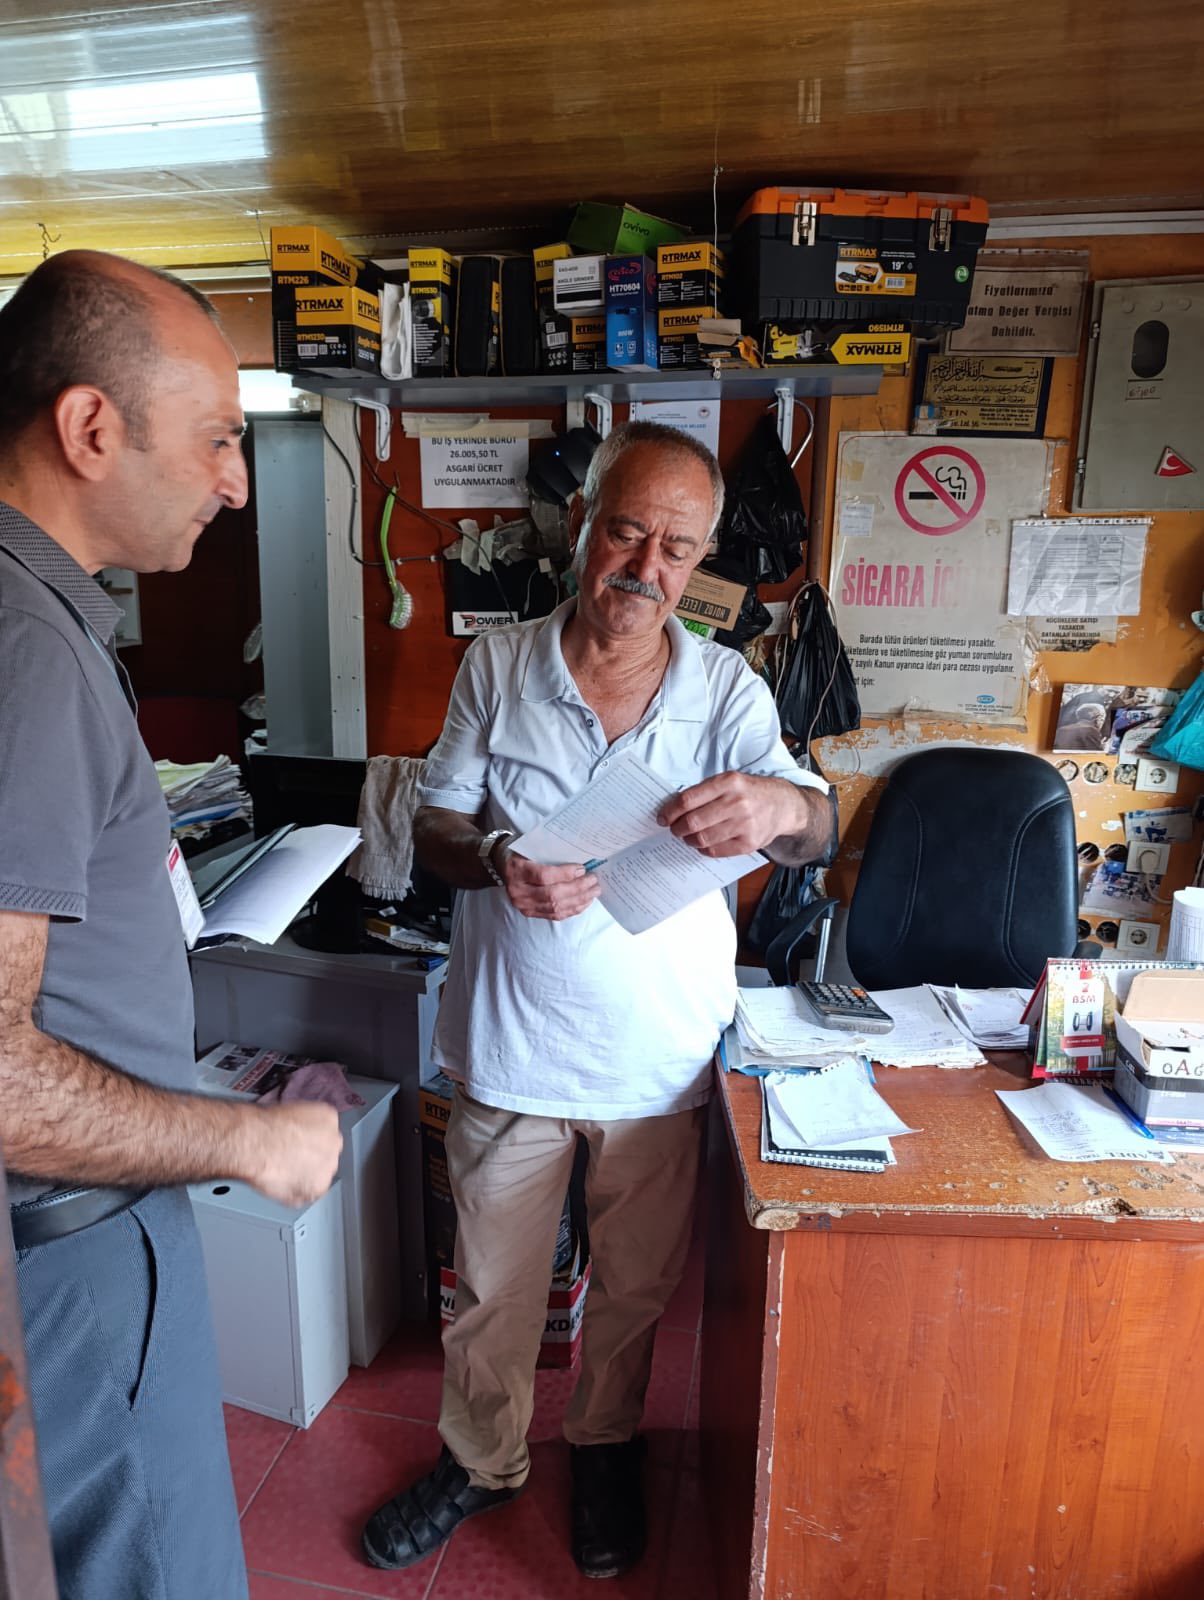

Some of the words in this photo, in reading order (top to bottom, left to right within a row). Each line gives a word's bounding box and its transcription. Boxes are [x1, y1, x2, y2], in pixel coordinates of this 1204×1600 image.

[277, 244, 310, 253] RTRMAX
[840, 248, 878, 257] RTRMAX
[662, 251, 701, 262] RTRMAX
[321, 250, 351, 279] RTRMAX
[609, 282, 641, 293] HT70604
[296, 298, 344, 310] RTRMAX
[967, 306, 994, 316] atma
[998, 305, 1029, 317] Değer
[1035, 305, 1072, 317] Vergisi
[846, 344, 902, 356] RTRMAX
[450, 450, 488, 459] 26.005,50
[490, 450, 499, 458] TL
[446, 463, 475, 472] ASGARİ
[477, 463, 503, 472] ÜCRET
[434, 478, 516, 486] UYGULANMAKTADIR
[842, 557, 925, 608] SİGARA
[460, 614, 513, 628] POWER
[860, 634, 883, 644] Burada
[885, 635, 901, 644] tütün
[903, 635, 928, 645] ürünleri
[930, 637, 966, 646] tüketilmesi
[968, 638, 996, 648] yasaktır.
[890, 648, 934, 658] tüketilmesine
[935, 649, 947, 660] göz
[948, 652, 970, 660] yuman
[972, 651, 1013, 660] sorumlulara
[874, 660, 895, 668] Kanun
[896, 661, 924, 671] uyarınca
[926, 661, 941, 670] idari
[942, 663, 958, 672] para
[960, 663, 980, 672] cezası
[982, 664, 1014, 674] uygulanır.
[1072, 995, 1096, 1004] BSM
